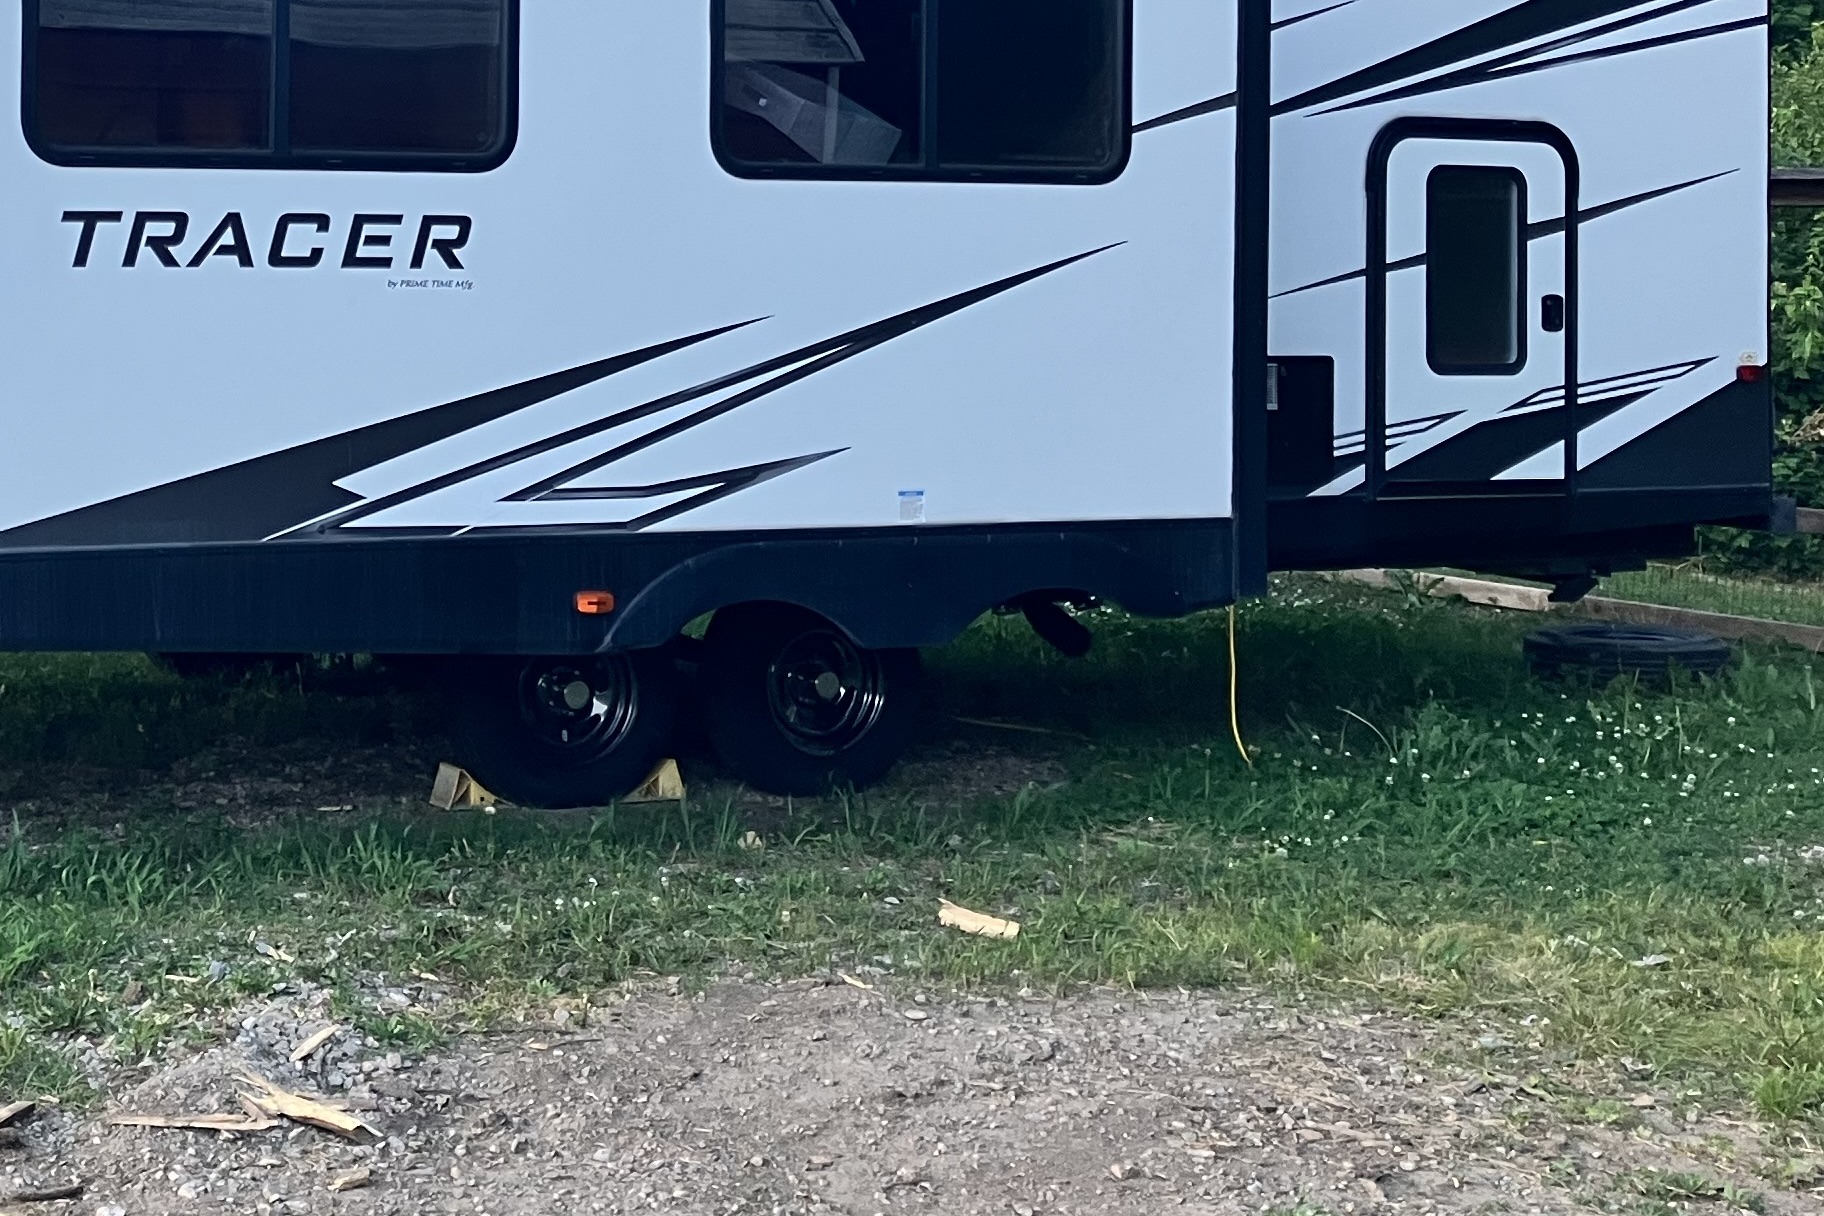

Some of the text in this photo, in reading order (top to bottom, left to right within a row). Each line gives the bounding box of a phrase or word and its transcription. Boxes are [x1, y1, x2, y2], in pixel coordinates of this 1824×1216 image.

[61, 211, 473, 269] TRACER
[387, 279, 398, 290] by
[399, 279, 429, 288] PRIME
[431, 279, 454, 288] TIME
